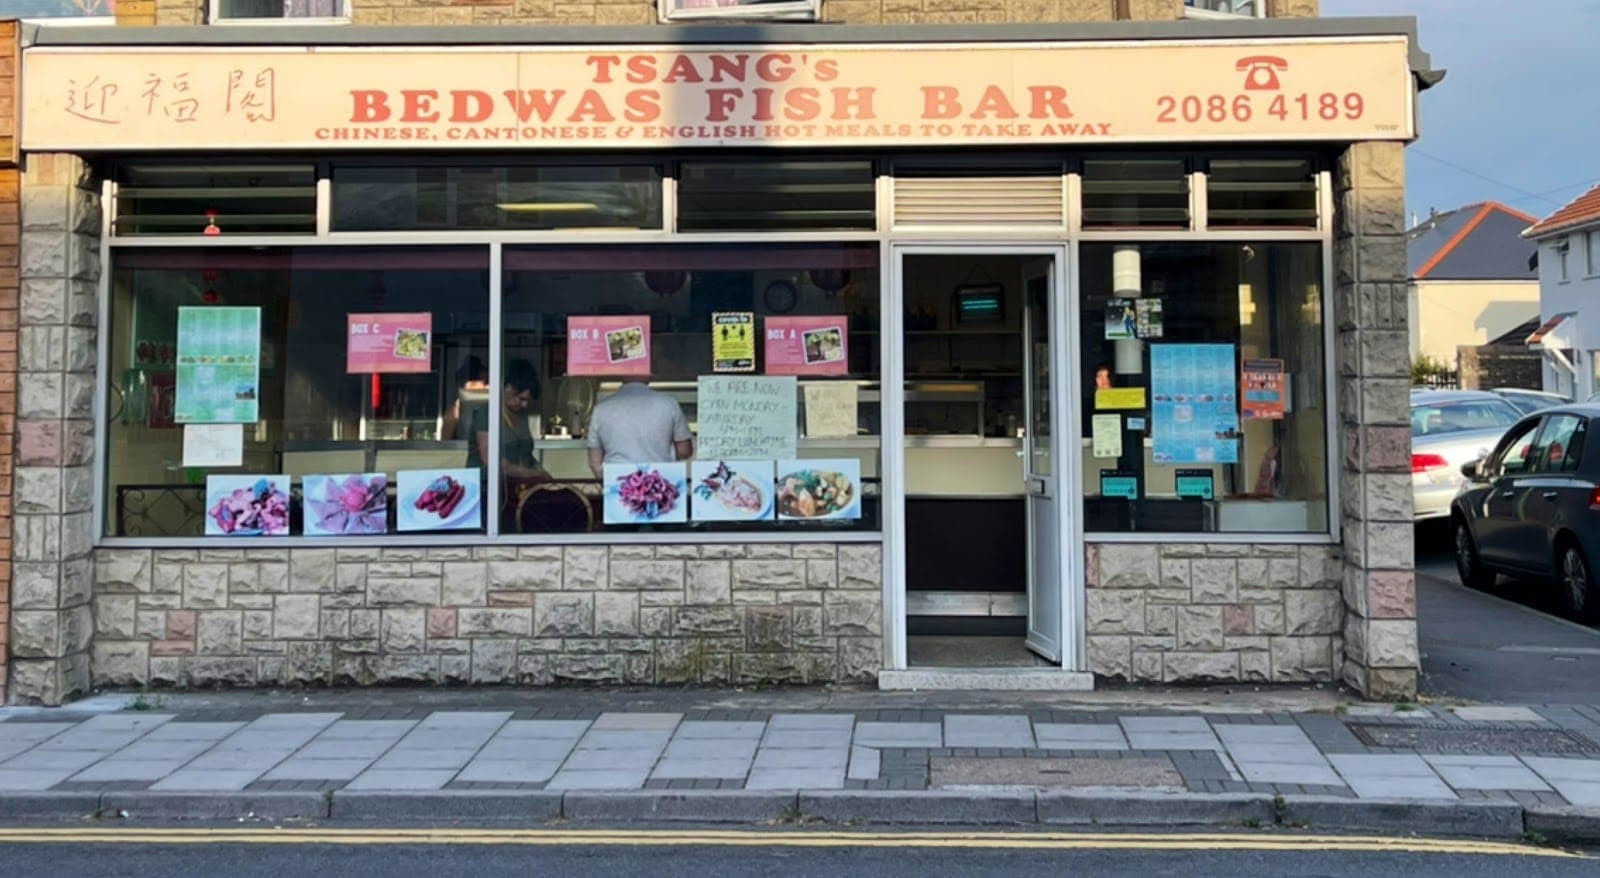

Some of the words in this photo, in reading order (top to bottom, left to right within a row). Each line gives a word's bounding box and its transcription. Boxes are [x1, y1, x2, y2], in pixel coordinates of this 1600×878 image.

[349, 88, 662, 123] BEDWAS
[705, 86, 877, 122] FISH
[920, 84, 1074, 120] BAR
[1156, 94, 1253, 124] 2086
[1267, 92, 1365, 121] 4189
[314, 127, 438, 142] CHINESE,
[446, 126, 604, 140] CANTONESE
[614, 126, 634, 139] &
[642, 125, 756, 139] ENGLISH
[761, 125, 818, 138] HOT
[825, 124, 912, 138] MEALS
[919, 124, 955, 137] TO
[960, 123, 1032, 137] TAKE
[1040, 122, 1113, 136] AWAY
[767, 328, 785, 340] BOX
[789, 328, 797, 340] A
